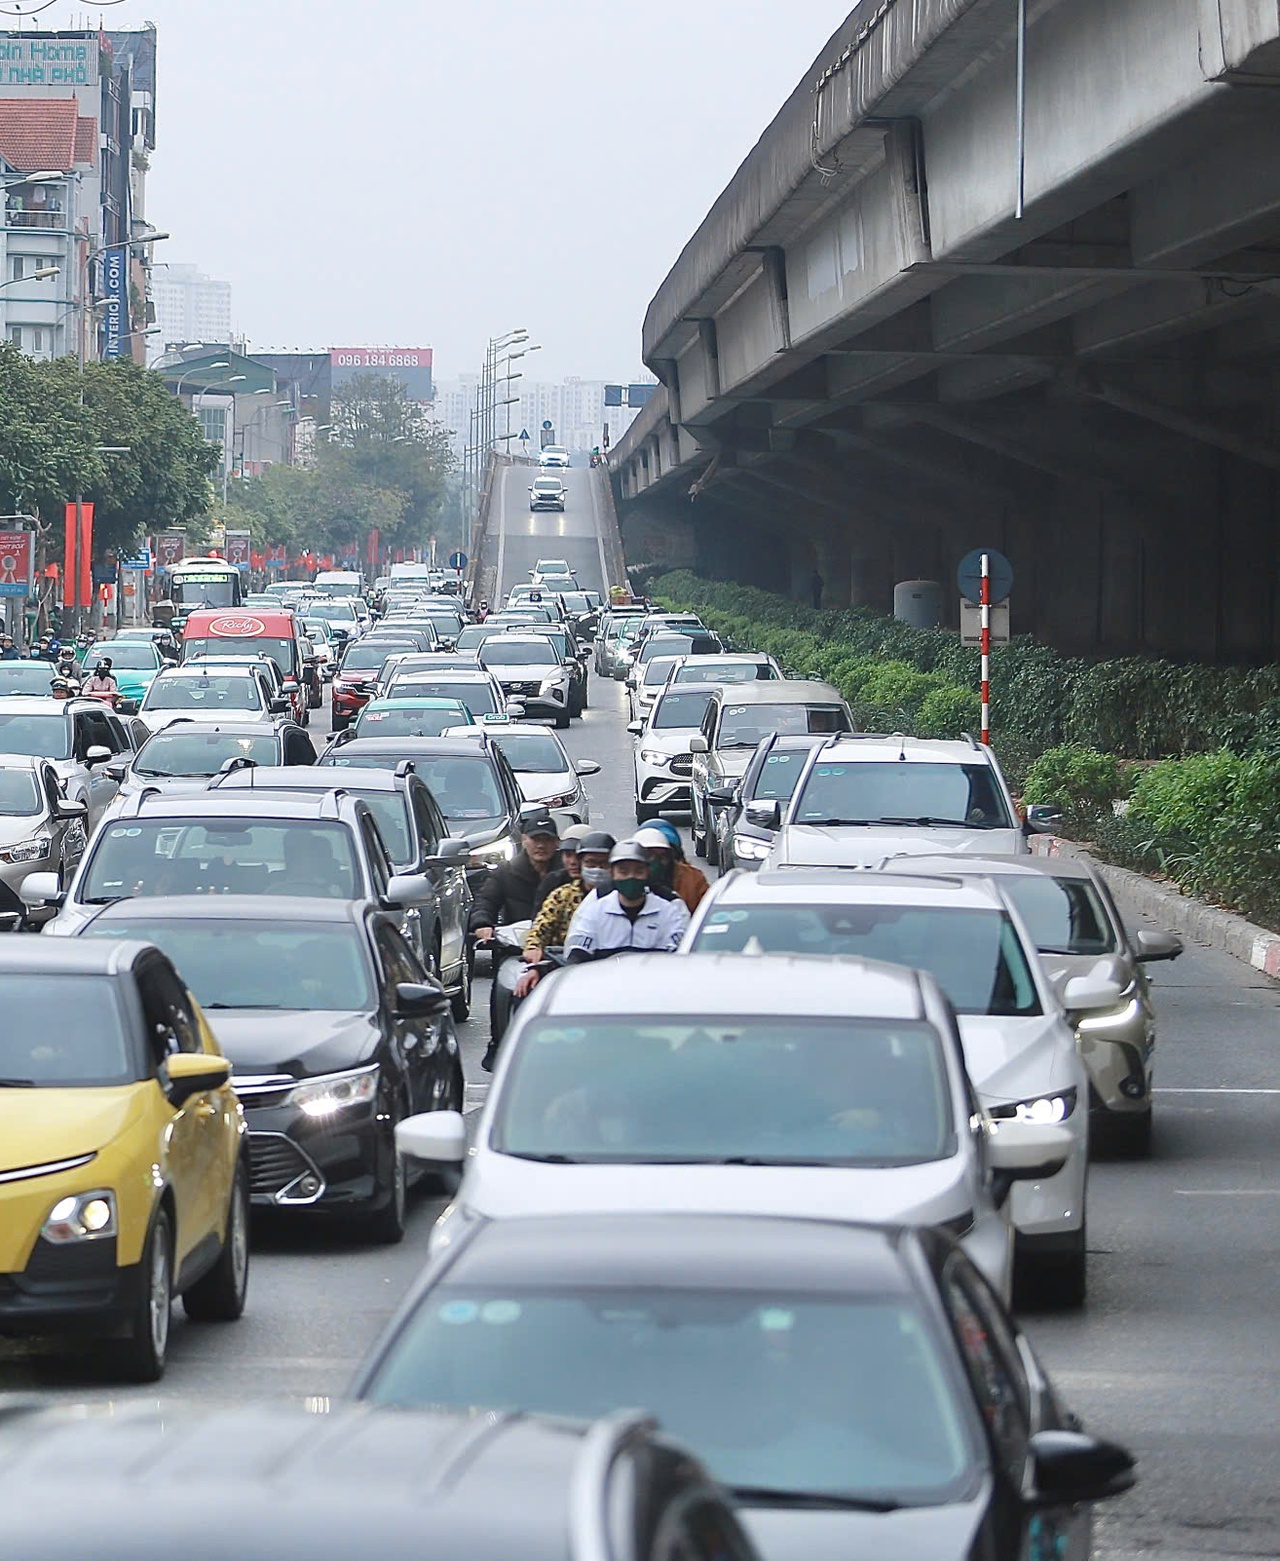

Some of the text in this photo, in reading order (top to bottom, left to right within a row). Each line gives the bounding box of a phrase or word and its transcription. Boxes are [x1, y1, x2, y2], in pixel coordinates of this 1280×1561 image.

[31, 41, 86, 60] Home
[109, 256, 119, 358] INTERIOR.COM
[338, 354, 419, 366] 096 184 6868
